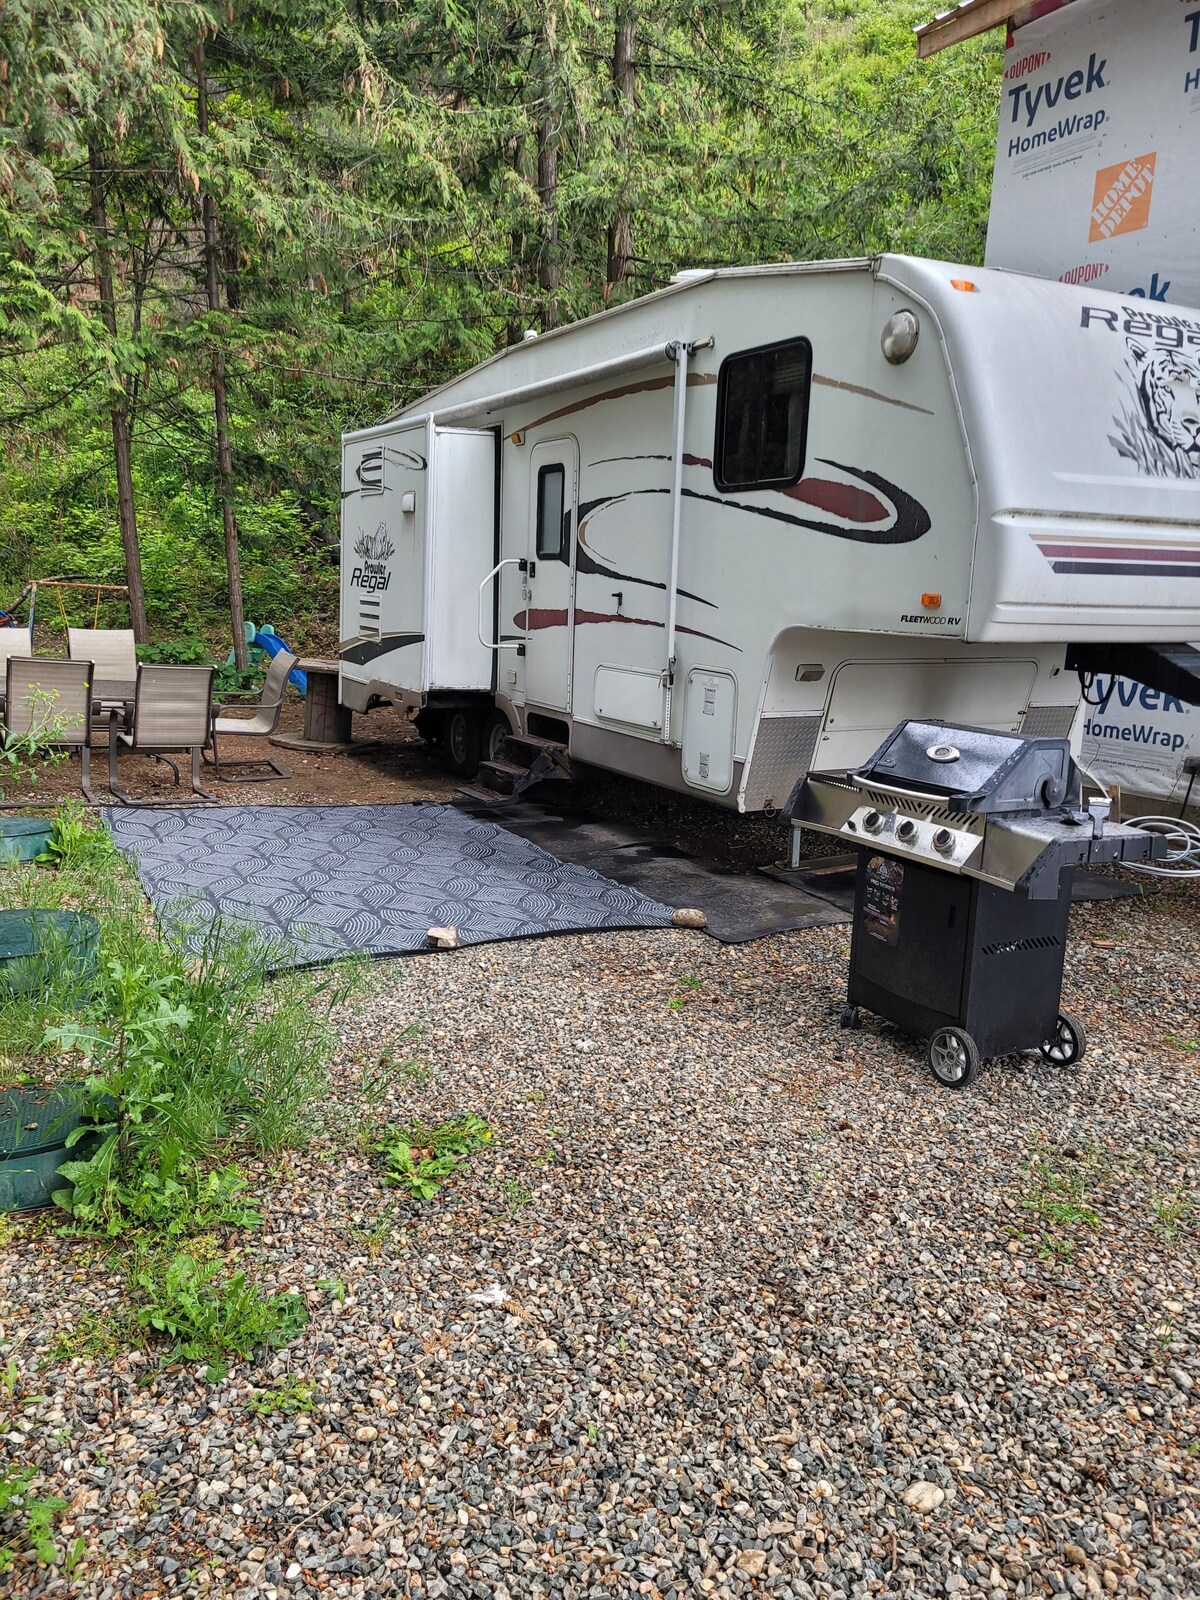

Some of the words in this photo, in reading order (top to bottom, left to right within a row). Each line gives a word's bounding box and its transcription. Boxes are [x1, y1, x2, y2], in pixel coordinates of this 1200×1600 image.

[1009, 52, 1047, 79] DUPONT
[1008, 53, 1107, 128] Tyvek
[1008, 109, 1106, 157] HomeWrap
[1091, 159, 1142, 225] HOME
[1099, 163, 1154, 239] DEPOT
[1064, 262, 1105, 285] DUPONT
[1080, 306, 1200, 349] Reg
[350, 567, 391, 593] Regal
[364, 560, 387, 576] Prowler
[900, 614, 946, 625] FLEETWOOD
[947, 617, 962, 625] RV
[1096, 679, 1184, 715] yvek
